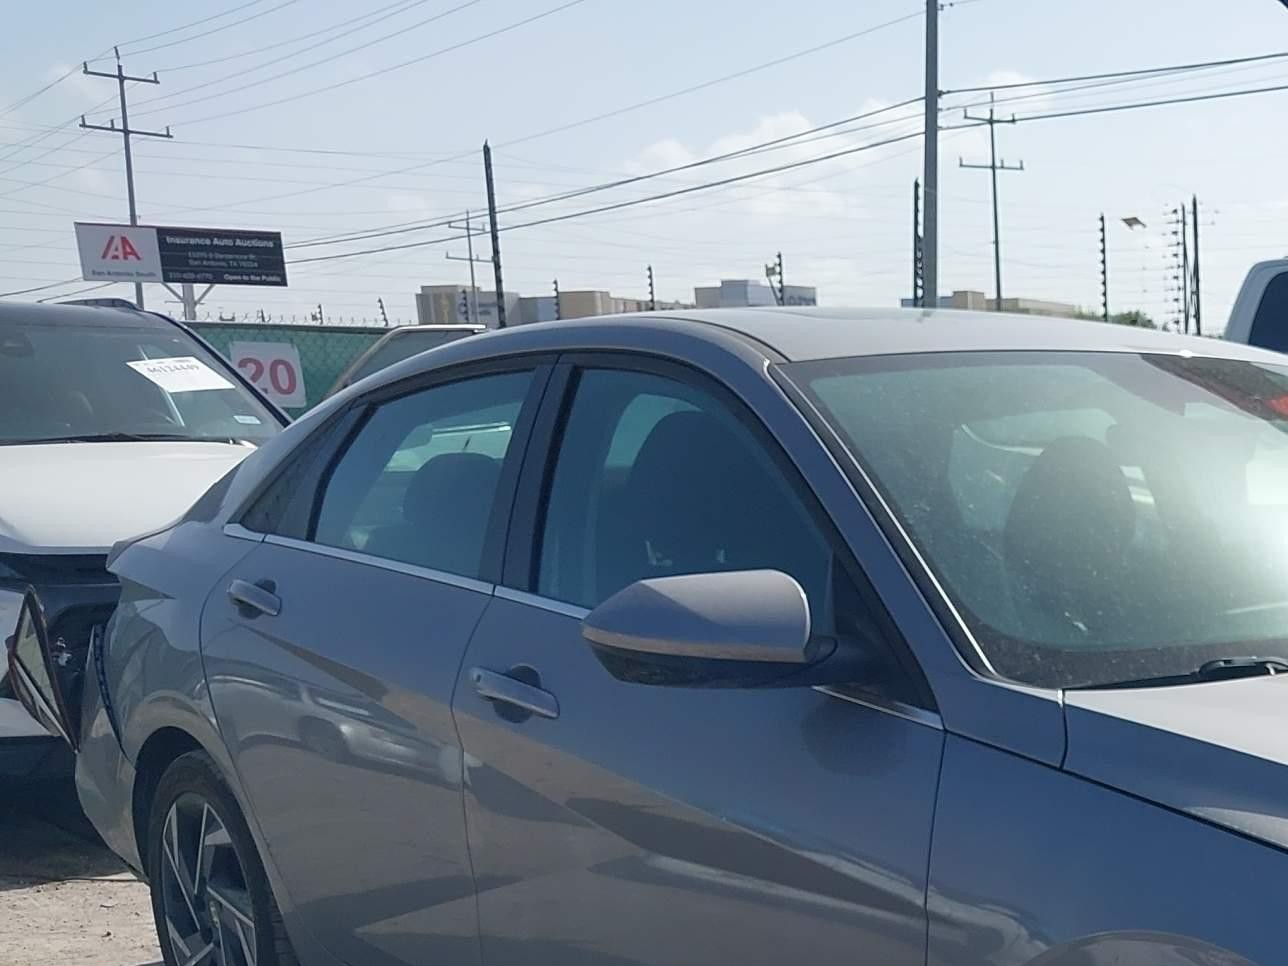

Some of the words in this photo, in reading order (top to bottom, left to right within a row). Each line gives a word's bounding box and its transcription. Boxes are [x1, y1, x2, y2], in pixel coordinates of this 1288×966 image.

[166, 236, 211, 245] Insurance
[212, 237, 234, 246] Auto
[235, 239, 274, 248] Auctions
[238, 358, 296, 395] 20
